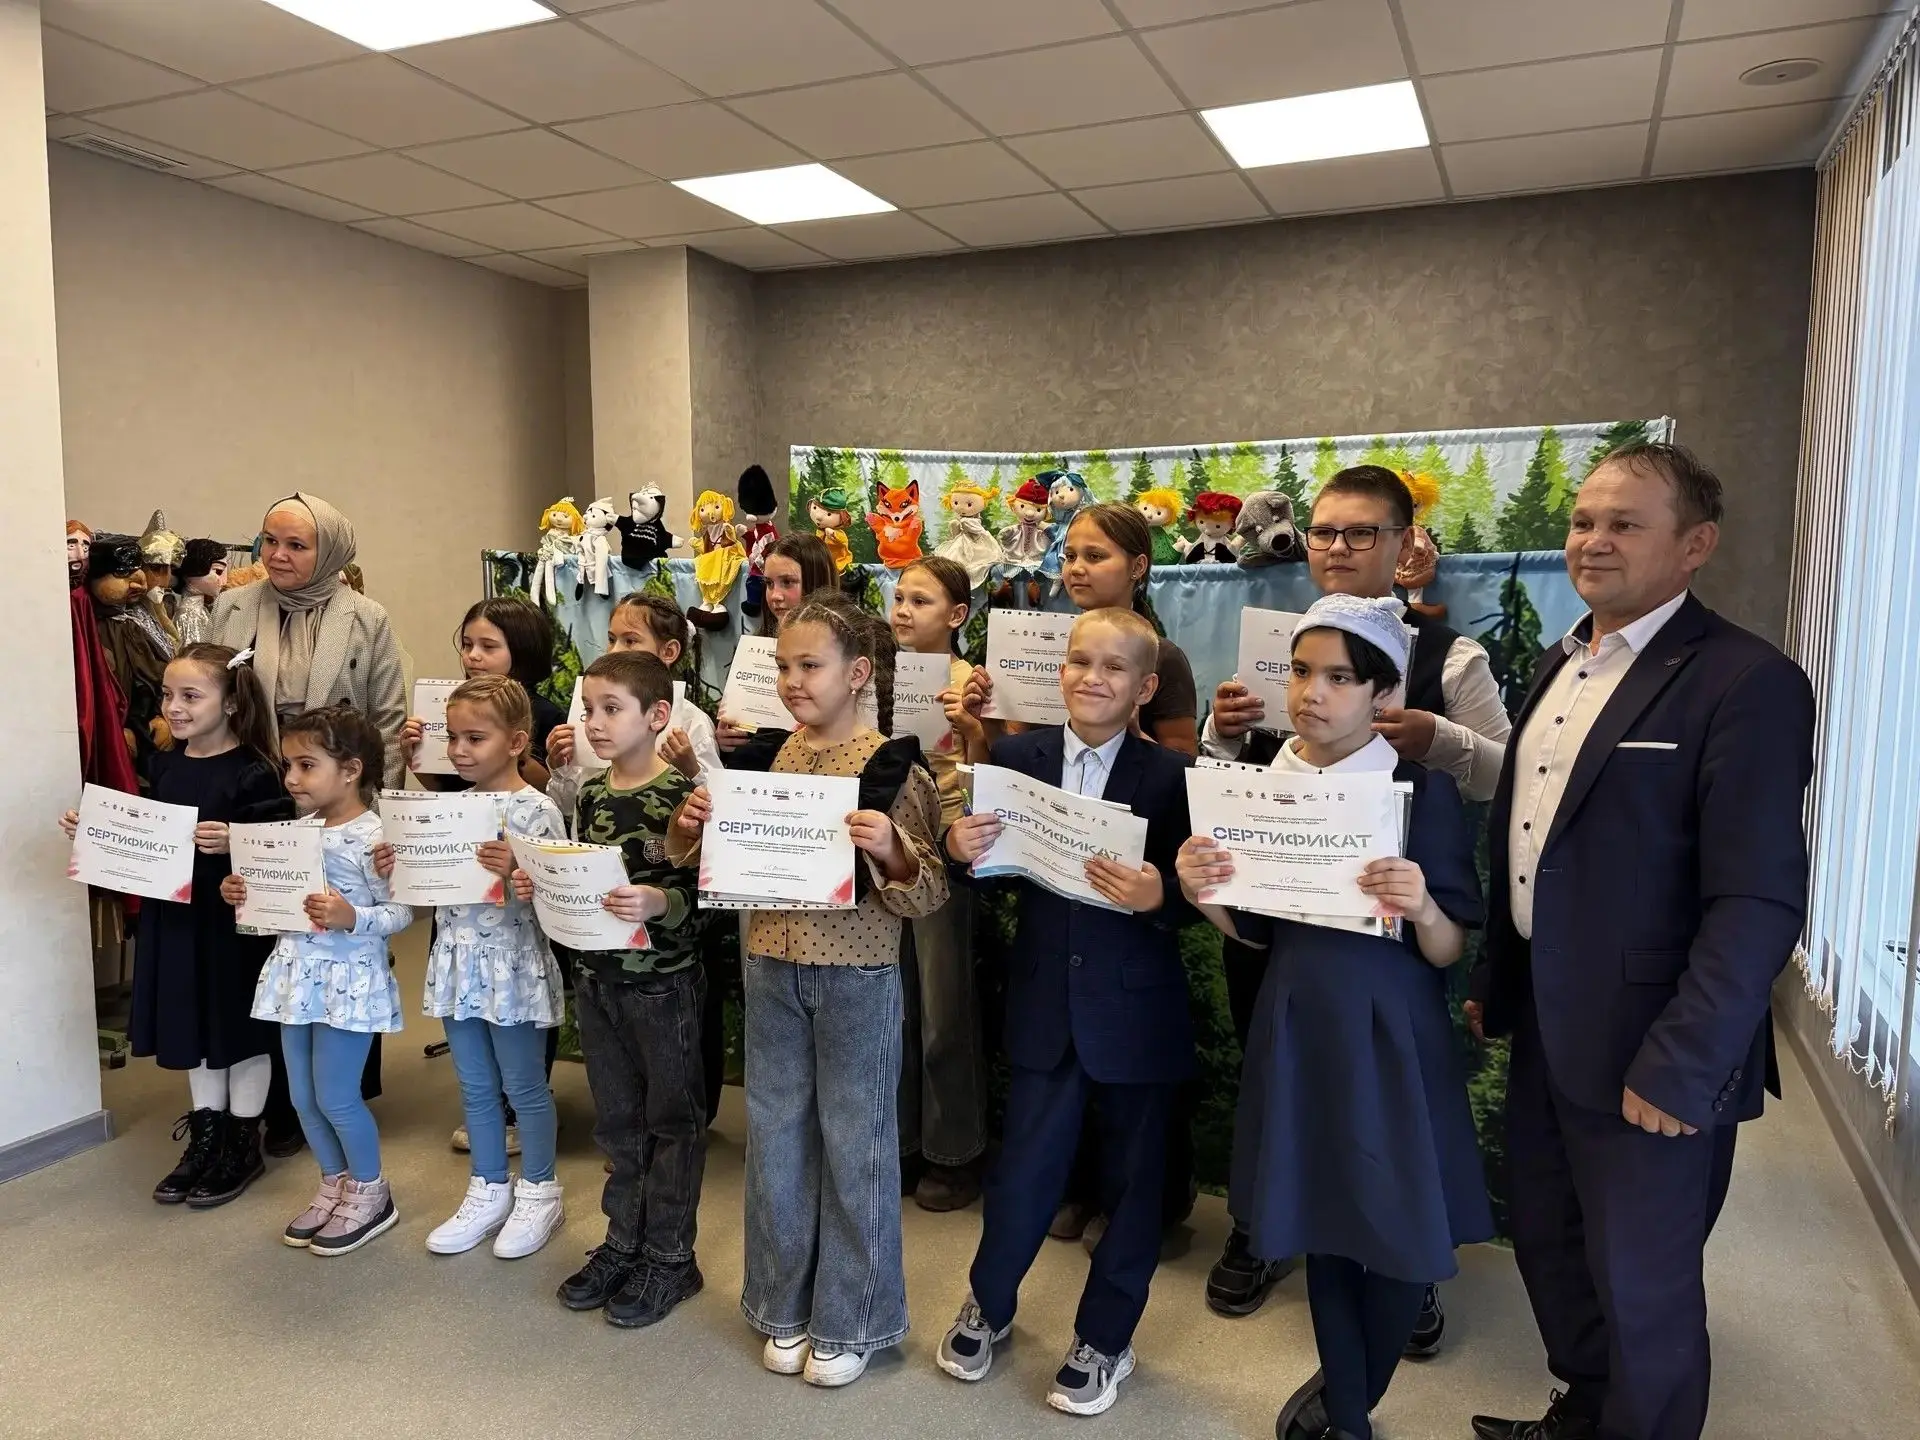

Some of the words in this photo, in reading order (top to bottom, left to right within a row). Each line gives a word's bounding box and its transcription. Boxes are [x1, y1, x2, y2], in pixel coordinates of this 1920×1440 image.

[1000, 659, 1061, 673] СЕРТИФ
[87, 826, 178, 855] СЕРТИФИКАТ
[718, 820, 838, 842] СЕРТИФИКАТ
[993, 808, 1122, 862] СЕРТИФИКАТ
[1212, 827, 1372, 849] СЕРТИФИКАТ
[240, 866, 310, 882] СЕРТИФИКАТ
